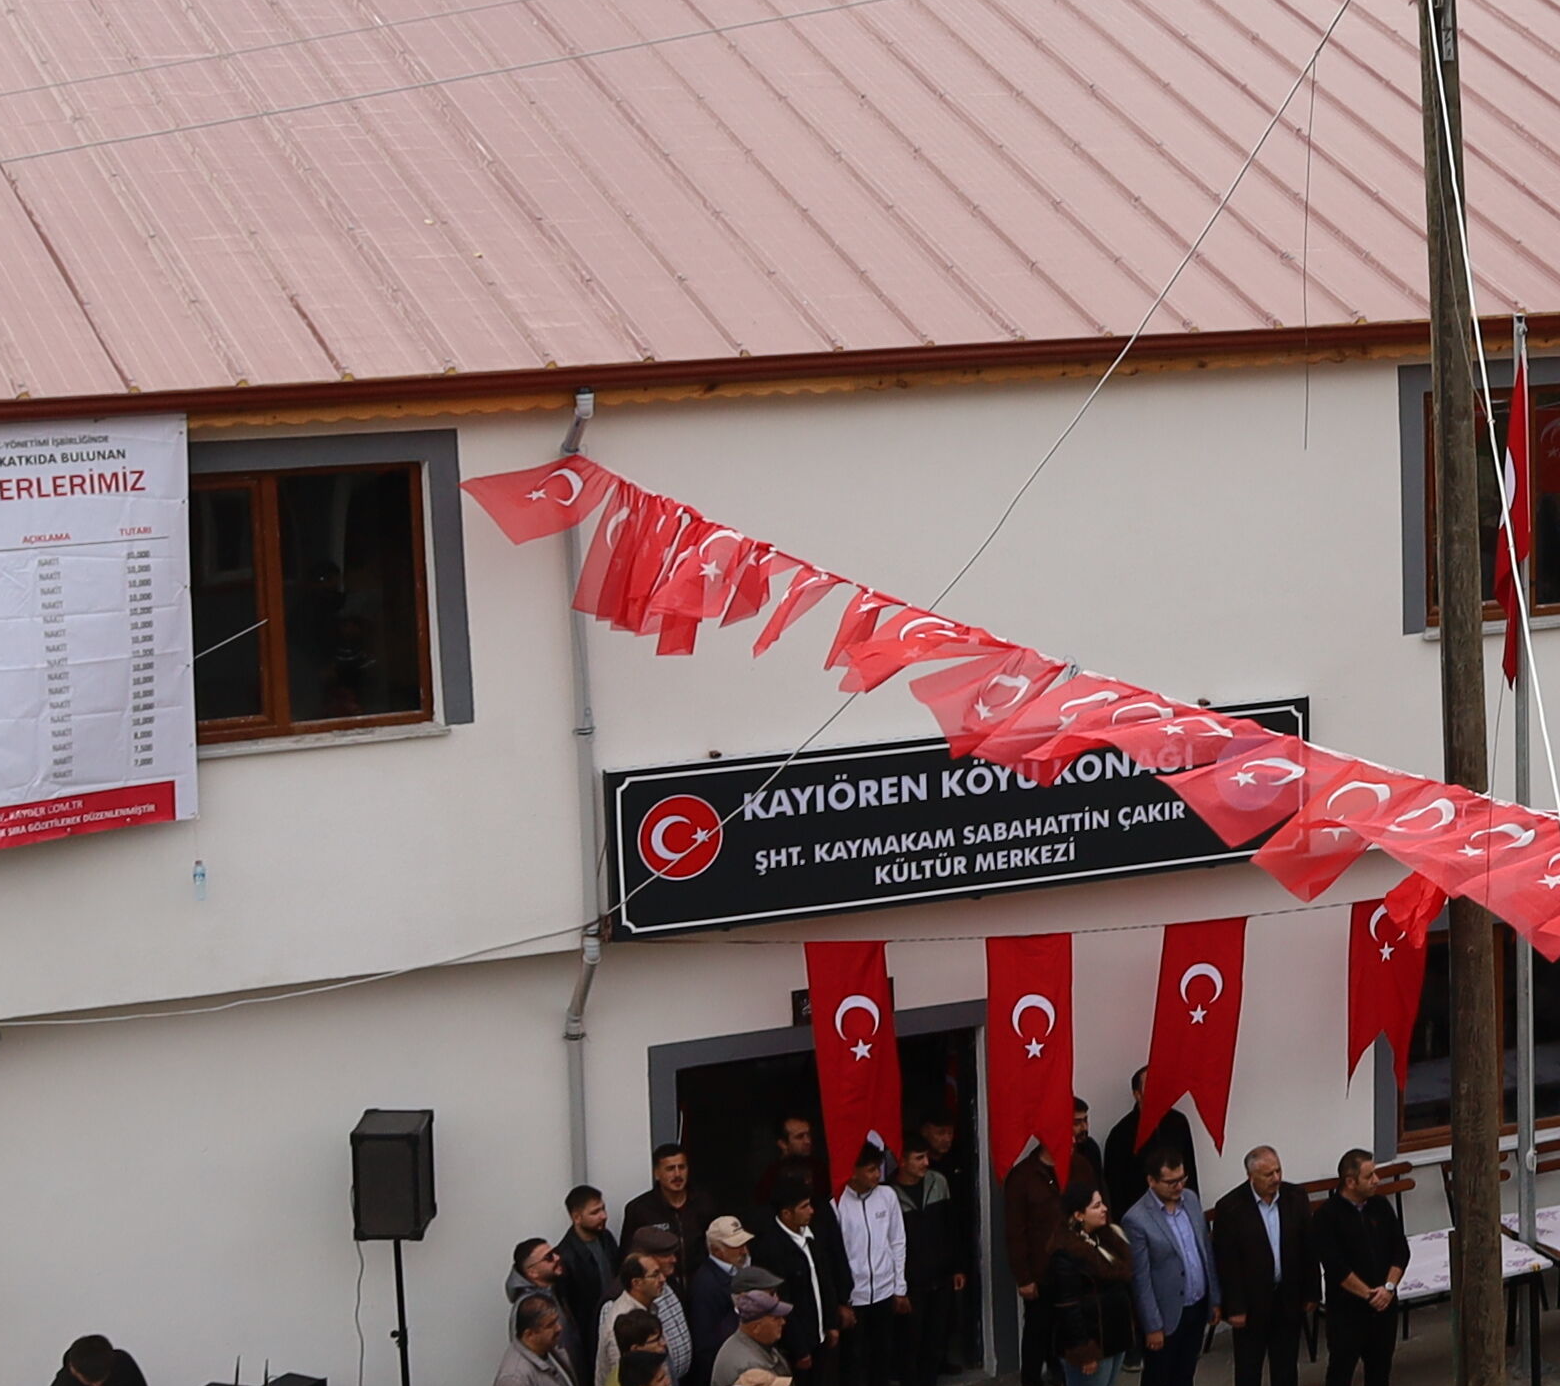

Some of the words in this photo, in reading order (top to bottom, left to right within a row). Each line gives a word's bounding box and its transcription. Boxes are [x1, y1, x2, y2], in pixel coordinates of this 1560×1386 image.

[52, 435, 109, 448] İŞBİRLİĞİNDE
[61, 449, 126, 463] BULUNAN
[22, 533, 71, 545] AÇIKLAMA
[119, 527, 152, 536] TUTARI
[743, 774, 928, 821] KAYIÖREN
[755, 846, 805, 875] ŞHT.
[814, 828, 955, 863] KAYMAKAM
[963, 807, 1110, 846] SABAHATTİN
[1117, 801, 1186, 831] ÇAKIR
[875, 853, 968, 885] KÜLTÜR
[974, 838, 1076, 873] MERKEZİ
